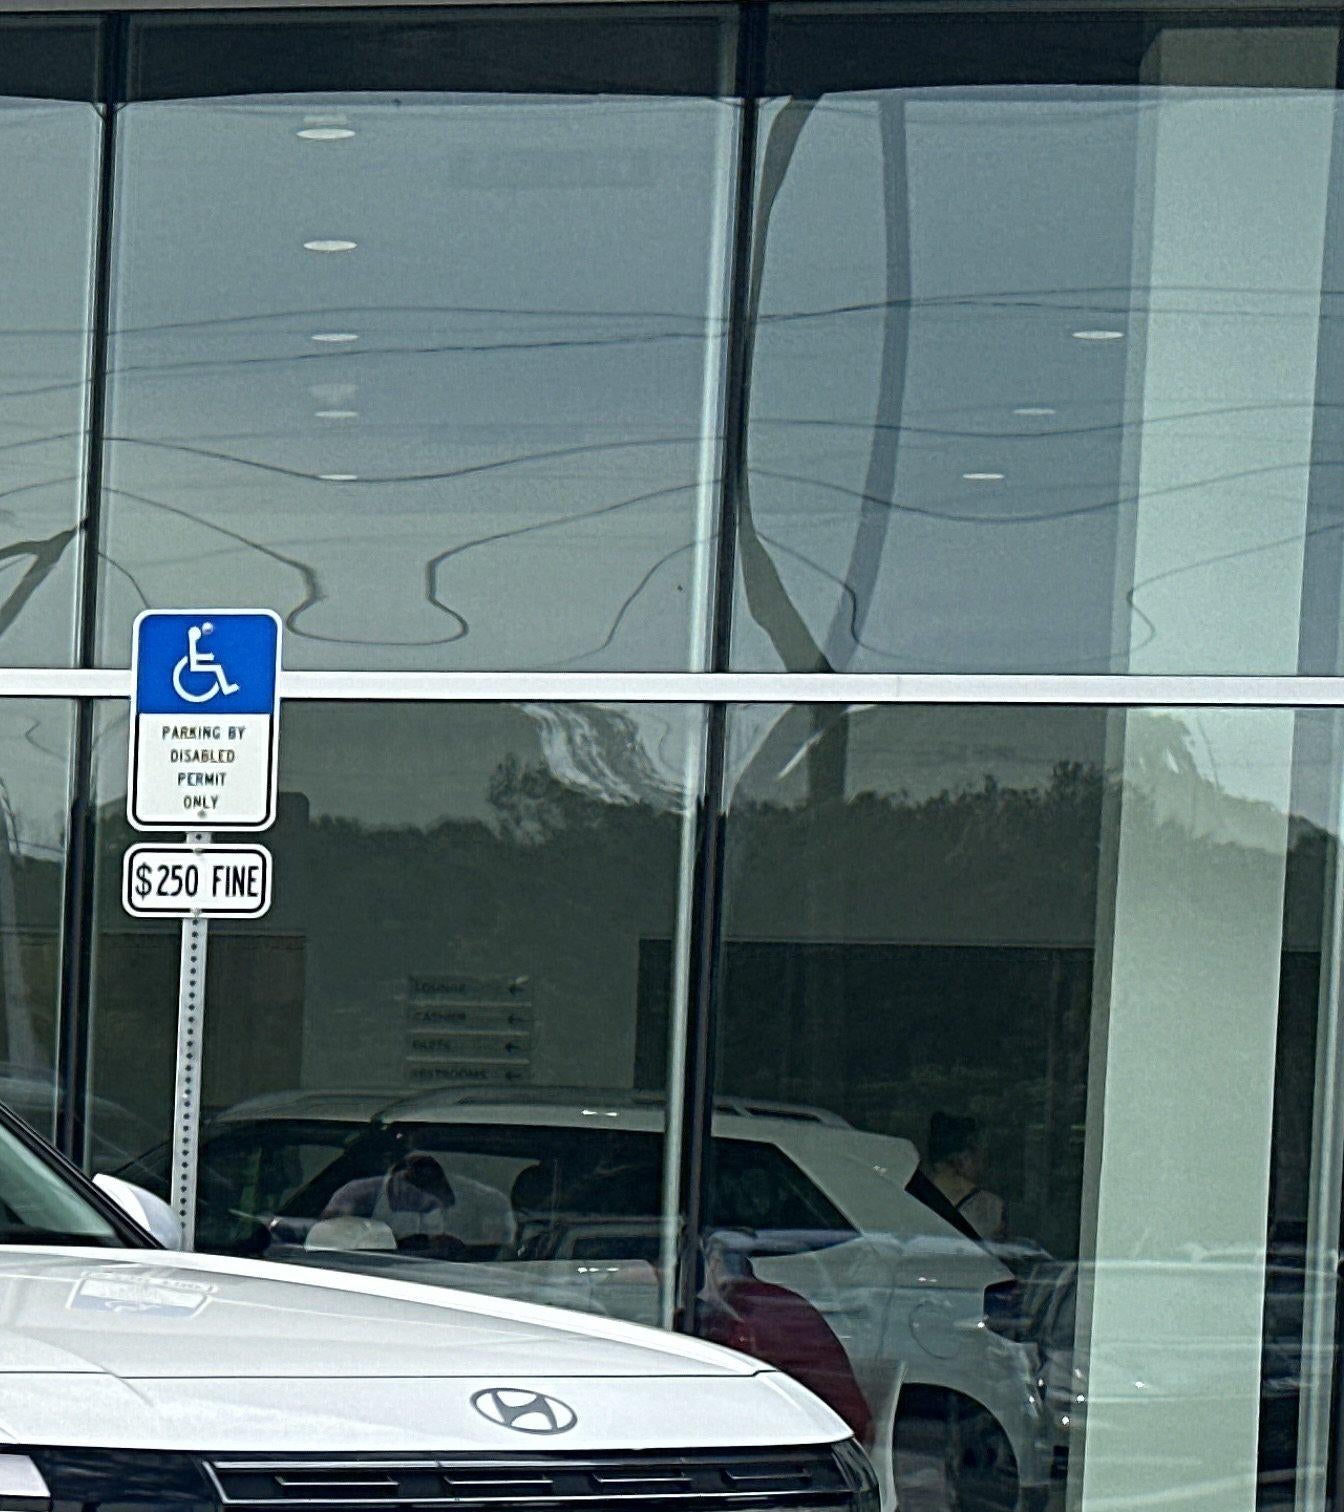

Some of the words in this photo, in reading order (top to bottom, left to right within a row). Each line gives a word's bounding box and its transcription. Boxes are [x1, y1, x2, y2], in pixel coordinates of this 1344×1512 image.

[162, 726, 221, 740] PARKING
[228, 726, 246, 740] BY
[170, 748, 236, 763] DISABLED
[177, 772, 227, 787] PERMIT
[183, 795, 219, 809] ONLY
[134, 862, 199, 901] $250
[212, 865, 260, 898] FINE
